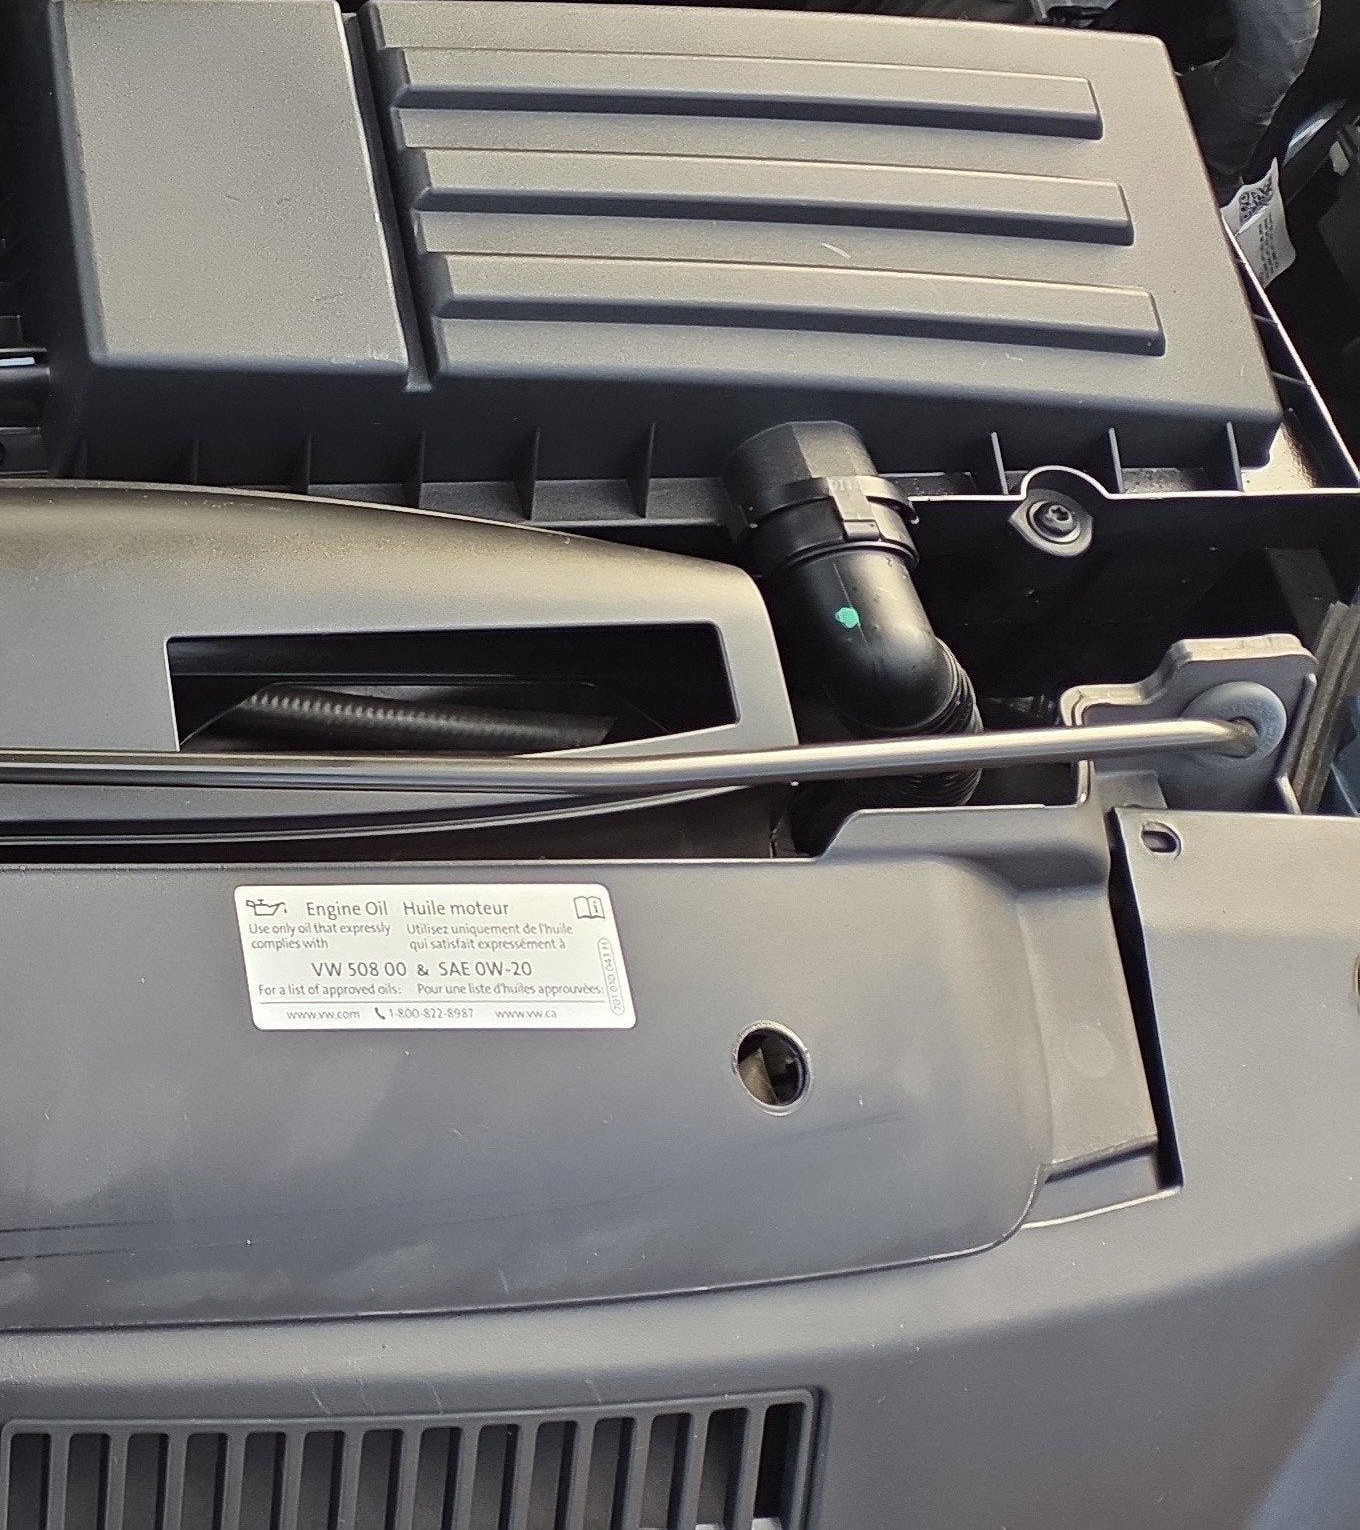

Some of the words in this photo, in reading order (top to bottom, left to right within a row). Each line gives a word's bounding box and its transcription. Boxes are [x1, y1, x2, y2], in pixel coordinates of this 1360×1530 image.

[306, 901, 362, 921] Engine
[365, 901, 388, 916] Oil
[403, 900, 446, 915] Huile
[450, 901, 509, 915] moteur
[249, 924, 270, 934] Use
[272, 923, 296, 937] only
[298, 923, 312, 934] oil
[314, 923, 338, 934] that
[340, 922, 391, 937] expressly
[407, 923, 449, 935] Utilisez
[451, 923, 521, 937] uniquement
[523, 923, 537, 934] de
[538, 923, 573, 935] l'huile
[251, 938, 301, 952] complies
[302, 938, 328, 948] with
[410, 939, 428, 953] qui
[430, 938, 475, 950] satisfait
[478, 938, 557, 953] expressément
[559, 938, 566, 949] à
[311, 962, 342, 977] VW
[348, 962, 379, 977] 508
[384, 962, 407, 976] 00
[417, 964, 429, 976] &
[438, 962, 470, 976] SAE
[475, 962, 532, 976] 0W-20
[258, 985, 276, 995] For
[279, 987, 286, 995] a
[288, 984, 306, 995] list
[308, 983, 320, 995] of
[323, 983, 376, 998] approved
[378, 983, 402, 995] oils:
[417, 983, 442, 995] Pour
[445, 986, 466, 994] une
[468, 983, 492, 995] liste
[494, 983, 536, 995] d'huiles
[286, 1011, 360, 1019] www.vw.com
